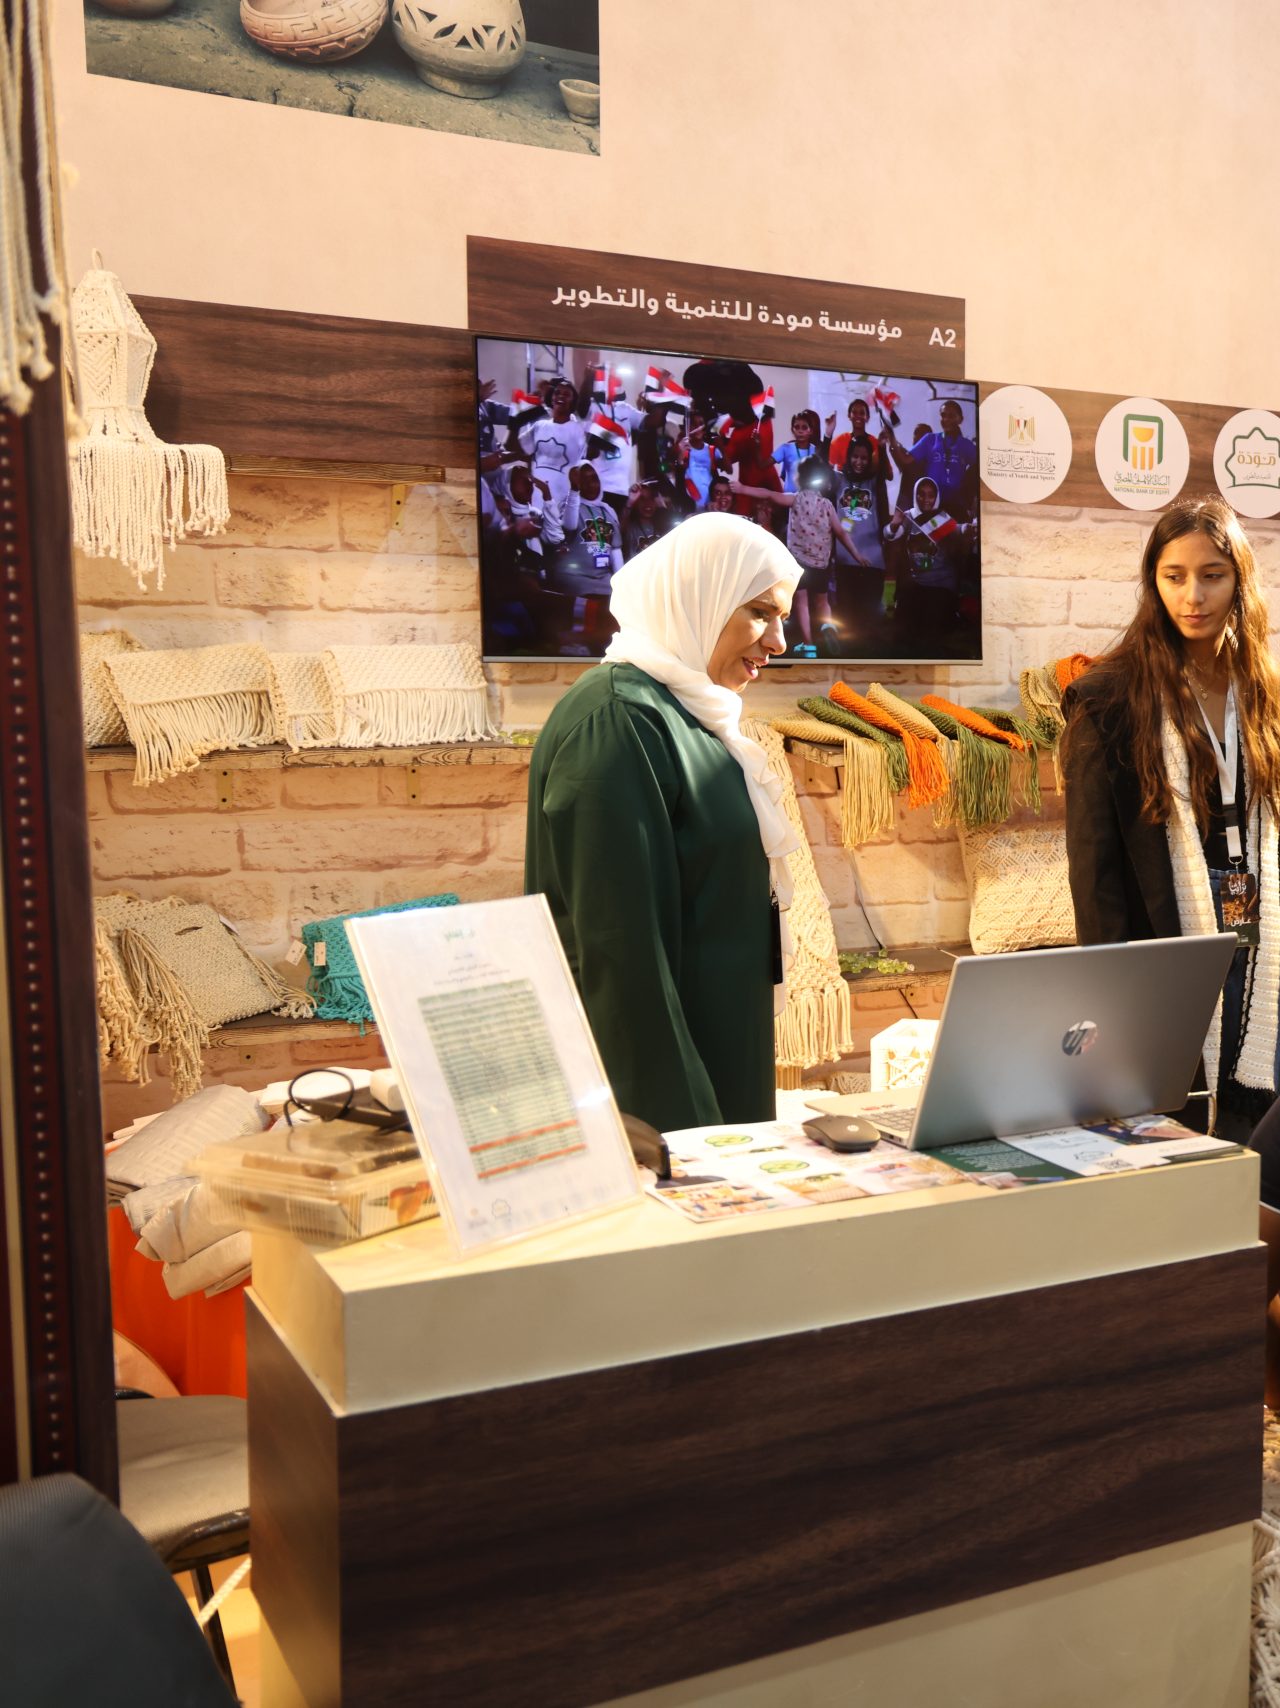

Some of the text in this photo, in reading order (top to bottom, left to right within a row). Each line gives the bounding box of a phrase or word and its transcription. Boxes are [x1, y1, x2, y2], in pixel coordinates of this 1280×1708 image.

[551, 284, 903, 342] مؤسسة مودة للتنمية والتطوير
[928, 328, 957, 349] A2
[1230, 914, 1252, 927] عارض
